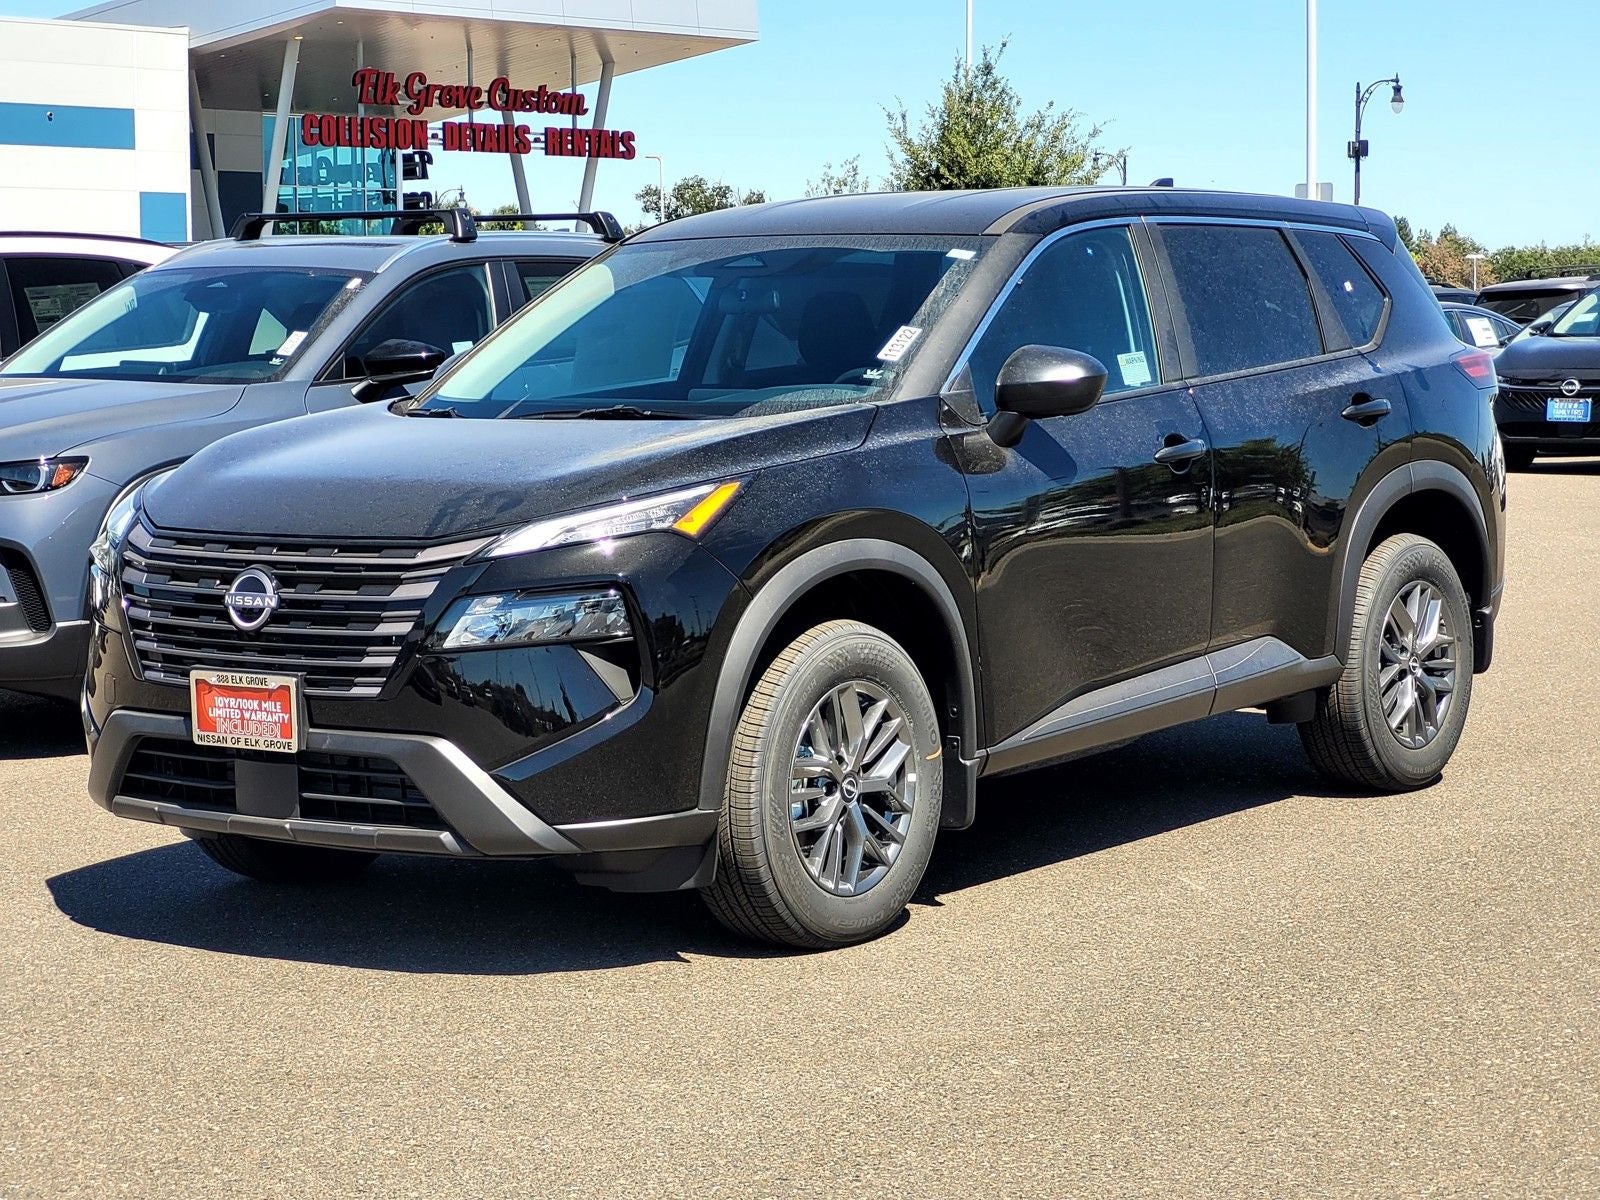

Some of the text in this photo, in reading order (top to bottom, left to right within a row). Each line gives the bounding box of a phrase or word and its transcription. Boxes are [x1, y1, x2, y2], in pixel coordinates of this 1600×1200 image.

[352, 67, 589, 116] Elk Grove Custom
[301, 113, 636, 161] COLLISION DETAILS RENTALS
[884, 329, 917, 358] 113122
[224, 594, 276, 607] NISSAN
[231, 675, 244, 685] ELK
[245, 676, 269, 687] GROVE
[214, 696, 282, 712] 10YR/100K MILE
[208, 707, 290, 724] LIMITED WARRANTY
[216, 719, 281, 738] INCLUDED!
[197, 734, 293, 751] NISSAN OF ELK GROVE
